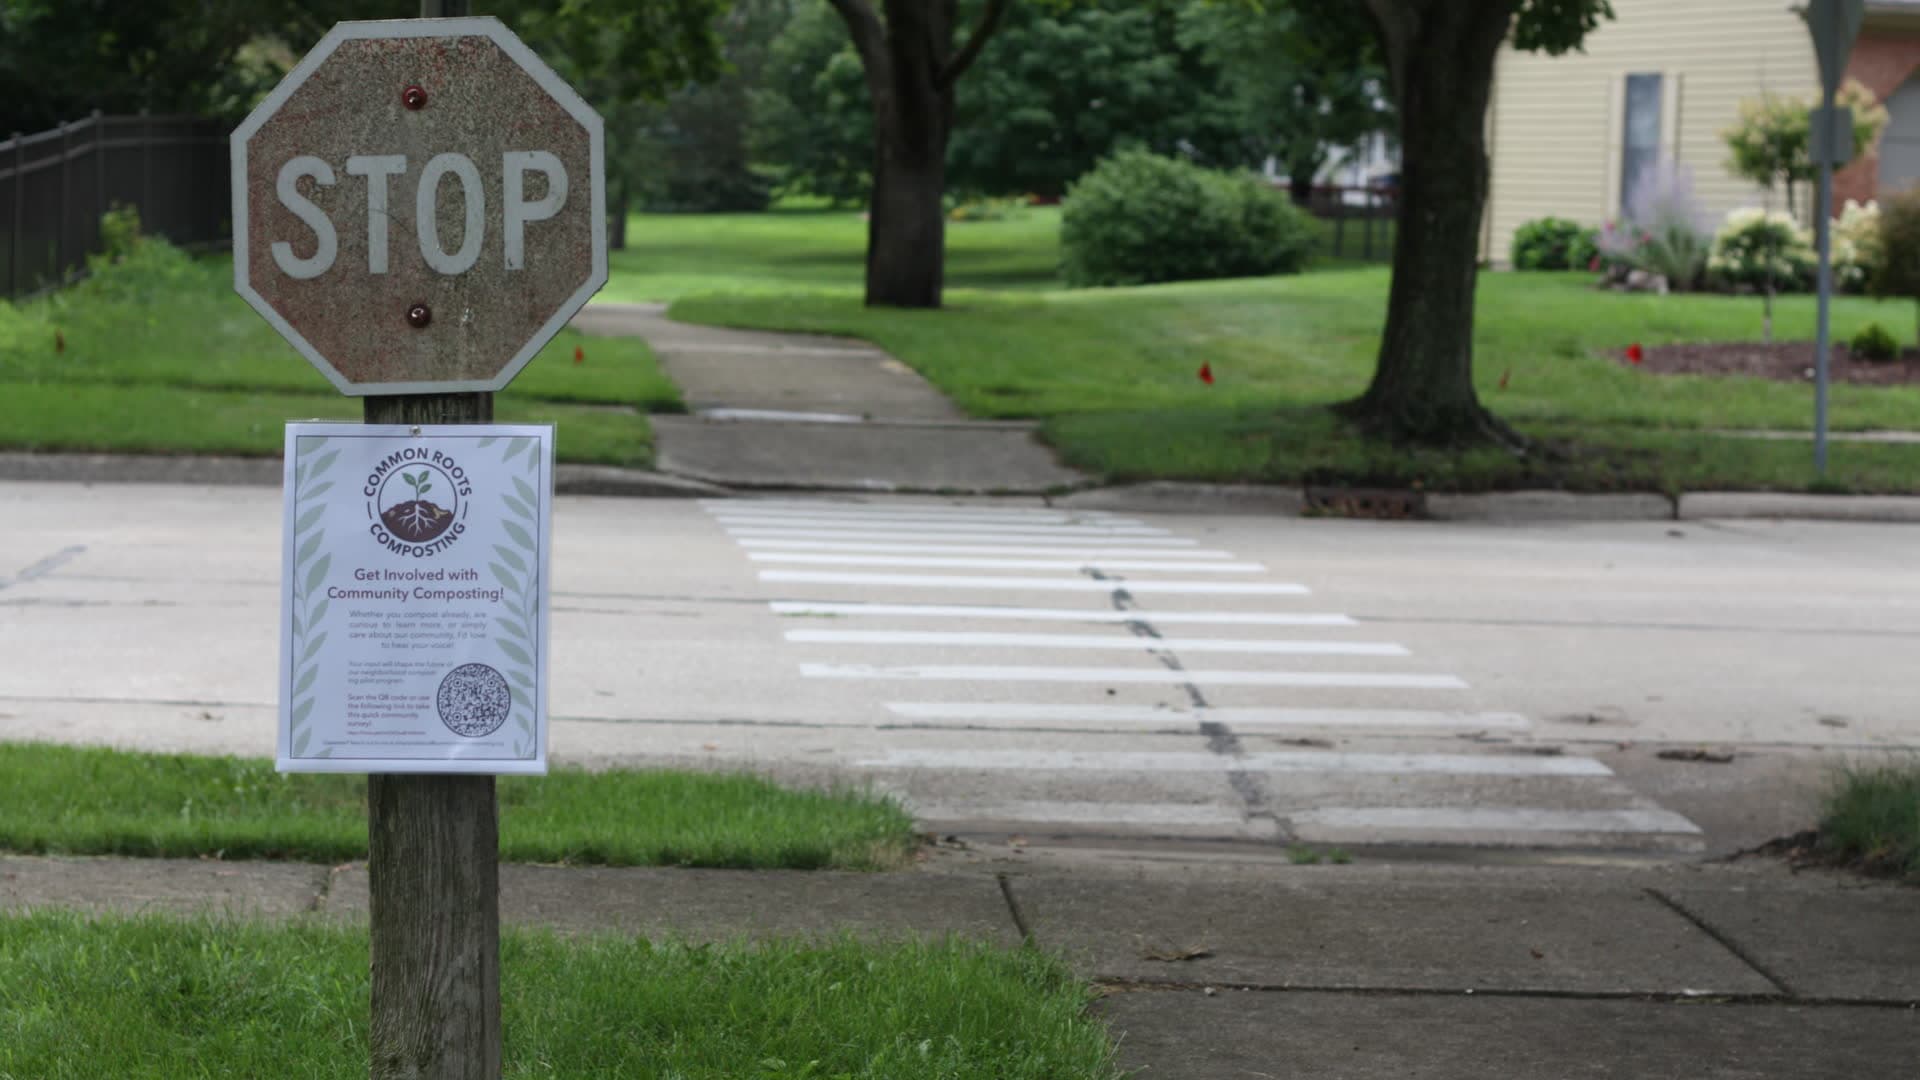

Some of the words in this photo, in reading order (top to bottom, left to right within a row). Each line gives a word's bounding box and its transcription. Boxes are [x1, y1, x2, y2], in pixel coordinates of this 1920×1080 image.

[271, 150, 568, 280] STOP
[364, 448, 428, 497] COMMON
[432, 450, 472, 496] ROOTS
[370, 522, 465, 558] COMPOSTING
[354, 568, 379, 581] Get
[384, 568, 444, 581] Involved
[448, 568, 478, 581] with
[327, 586, 409, 602] Community
[413, 587, 504, 602] Composting!
[348, 610, 383, 618] Whether
[387, 611, 401, 619] you
[404, 610, 438, 619] compost
[461, 621, 487, 630] simply
[381, 641, 390, 649] to
[391, 641, 408, 649] hear
[411, 642, 429, 650] your
